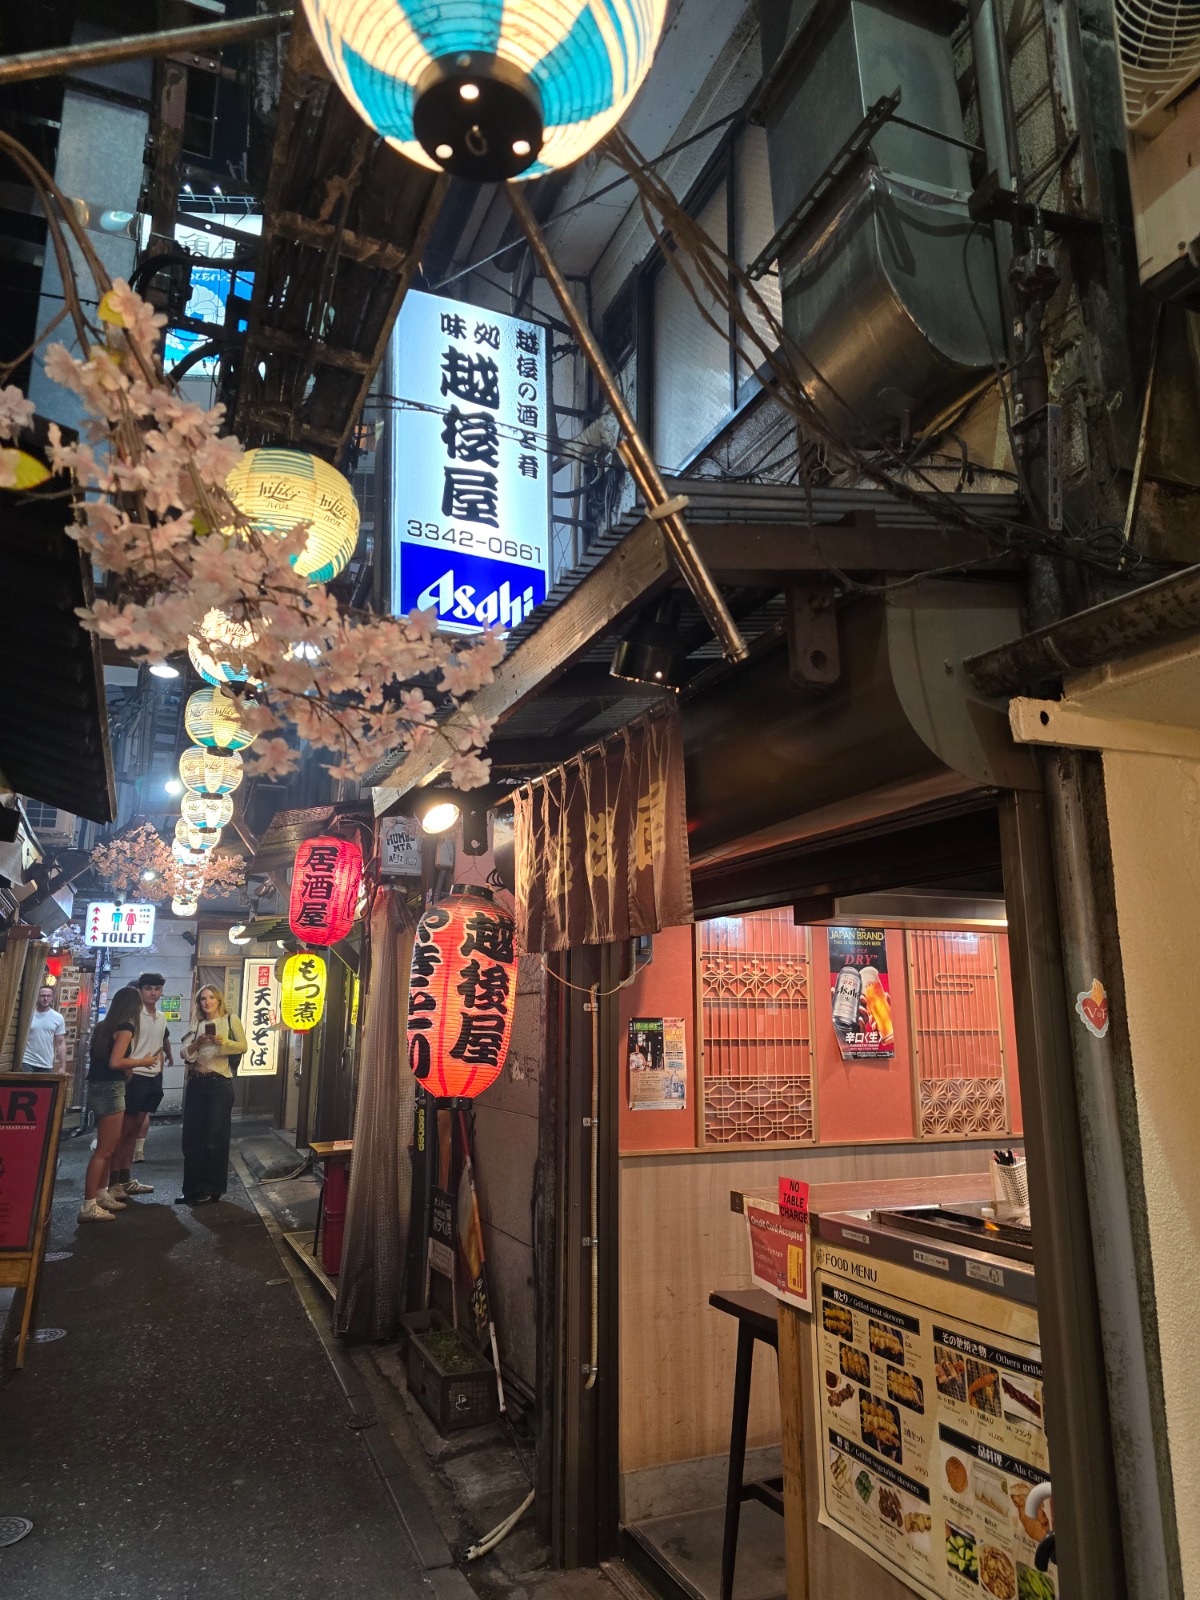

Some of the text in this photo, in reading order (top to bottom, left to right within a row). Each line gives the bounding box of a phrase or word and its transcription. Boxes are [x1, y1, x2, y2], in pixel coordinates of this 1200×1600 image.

[440, 312, 500, 350] 味処
[439, 345, 500, 529] 越後屋
[406, 519, 542, 564] 3342-0661
[417, 569, 534, 628] Asahi
[295, 846, 339, 928] 居酒屋
[101, 932, 145, 944] TOILET
[830, 931, 884, 941] JAPAN BRAND
[259, 968, 269, 985] 元祖
[293, 959, 318, 1023] もつ煮
[448, 911, 516, 1067] 越後屋
[249, 987, 271, 1066] 天玉そば
[783, 1193, 804, 1209] TABLE
[789, 1180, 800, 1193] NO
[780, 1206, 807, 1223] CHARGE
[779, 1225, 804, 1242] Accepted
[825, 1253, 877, 1282] FOOD MENU
[942, 1332, 987, 1359] その他焼き物
[995, 1352, 1021, 1369] Others
[1022, 1363, 1043, 1376] grille
[971, 1444, 1003, 1468] 一品料理
[1013, 1463, 1027, 1476] Ala
